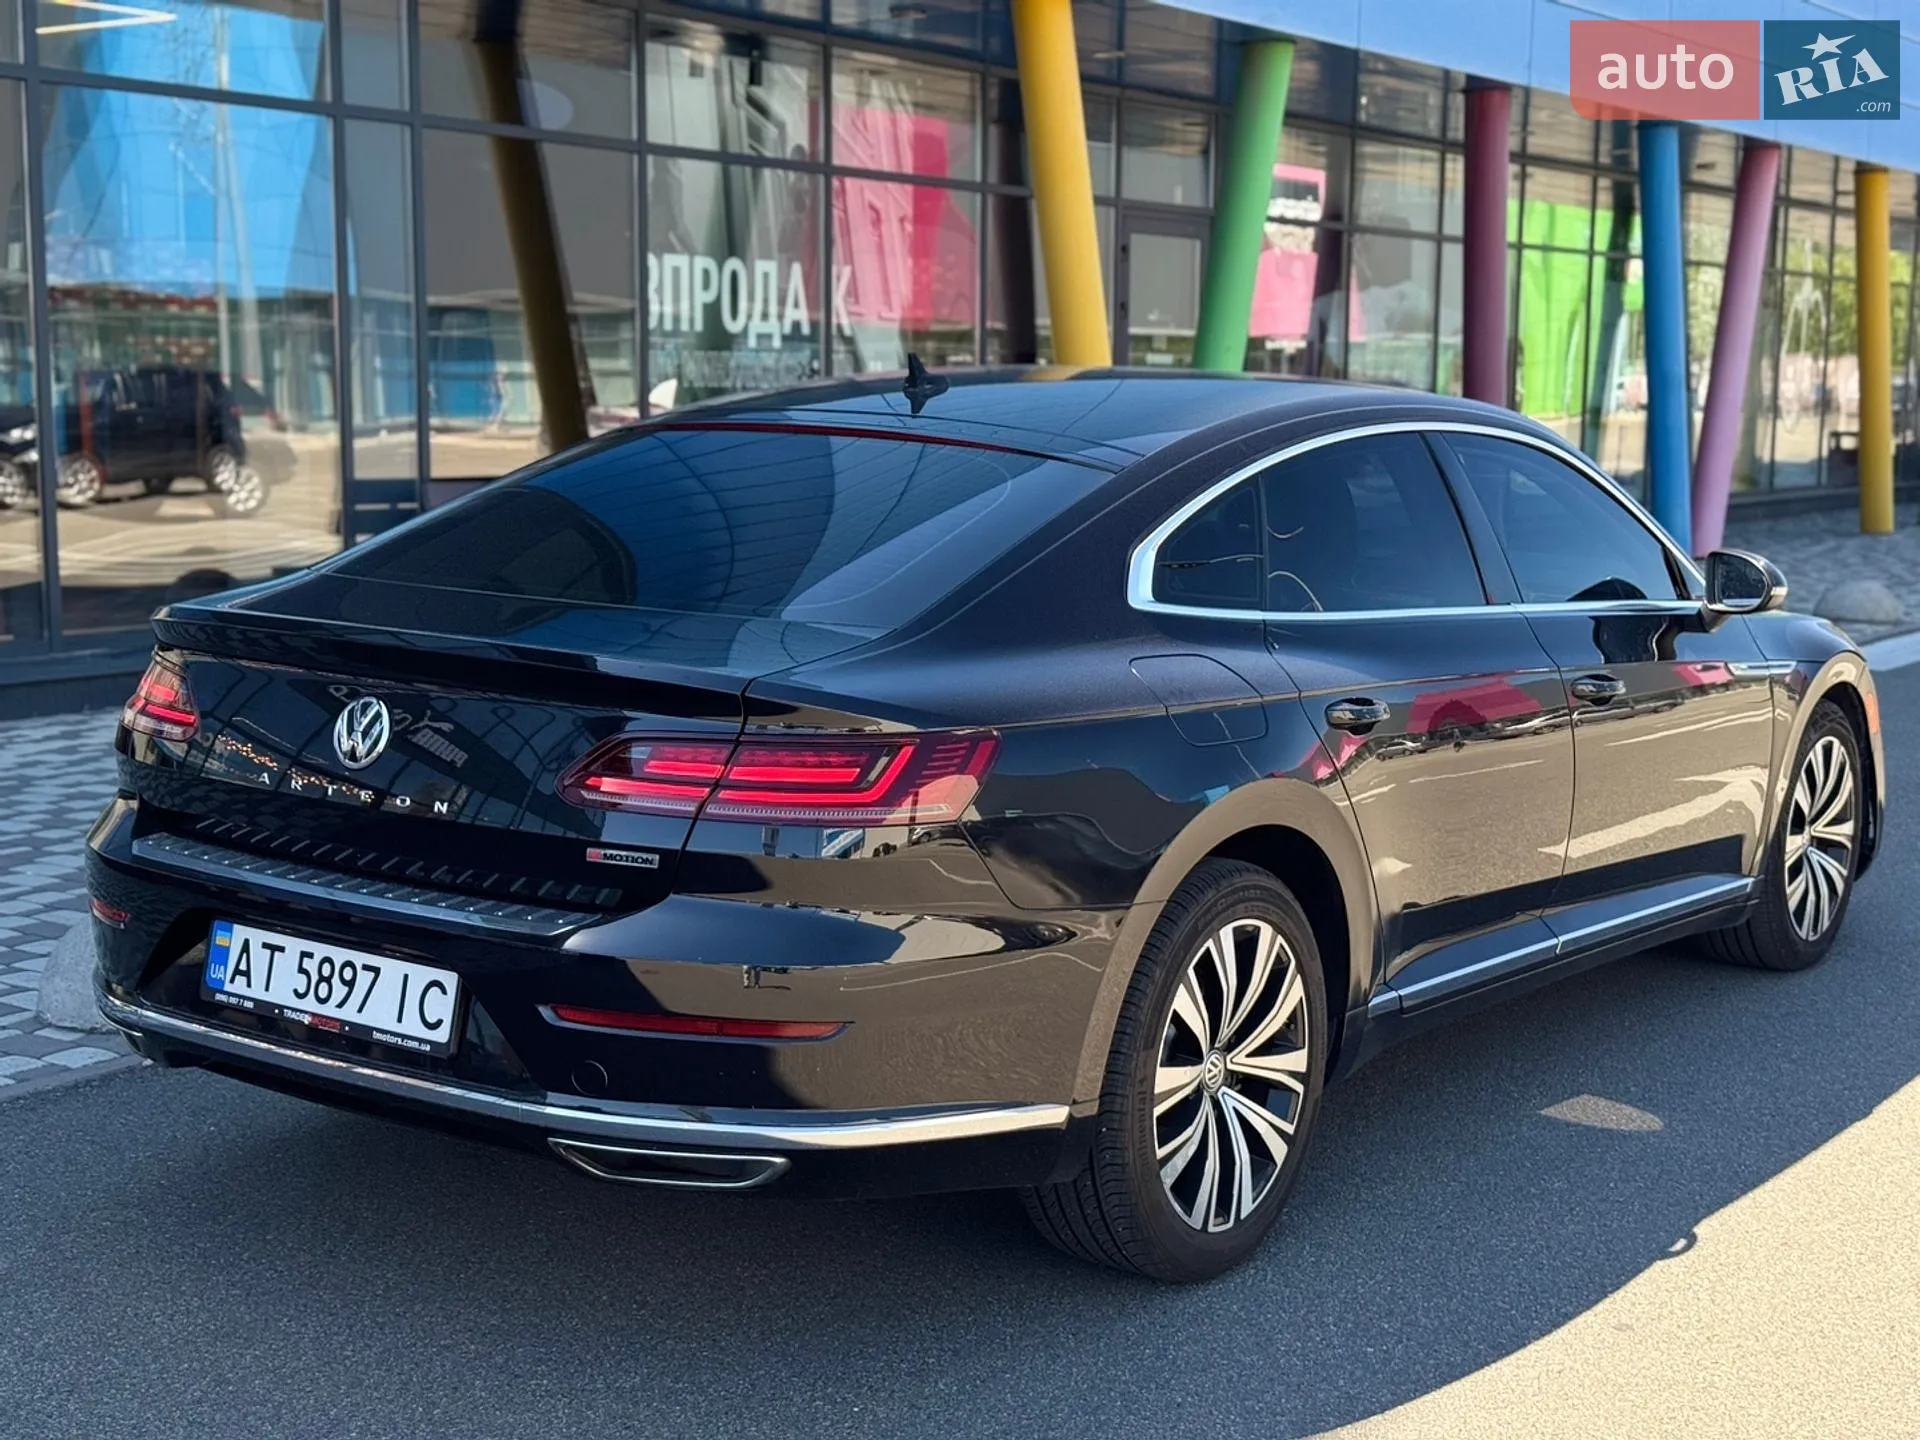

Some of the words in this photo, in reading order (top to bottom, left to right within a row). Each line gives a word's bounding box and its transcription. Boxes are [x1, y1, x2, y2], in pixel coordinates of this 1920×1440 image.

[258, 772, 449, 815] ARTEON
[211, 964, 224, 980] UA
[229, 938, 285, 992] AT
[293, 950, 381, 1014] 5897
[396, 973, 448, 1031] IC
